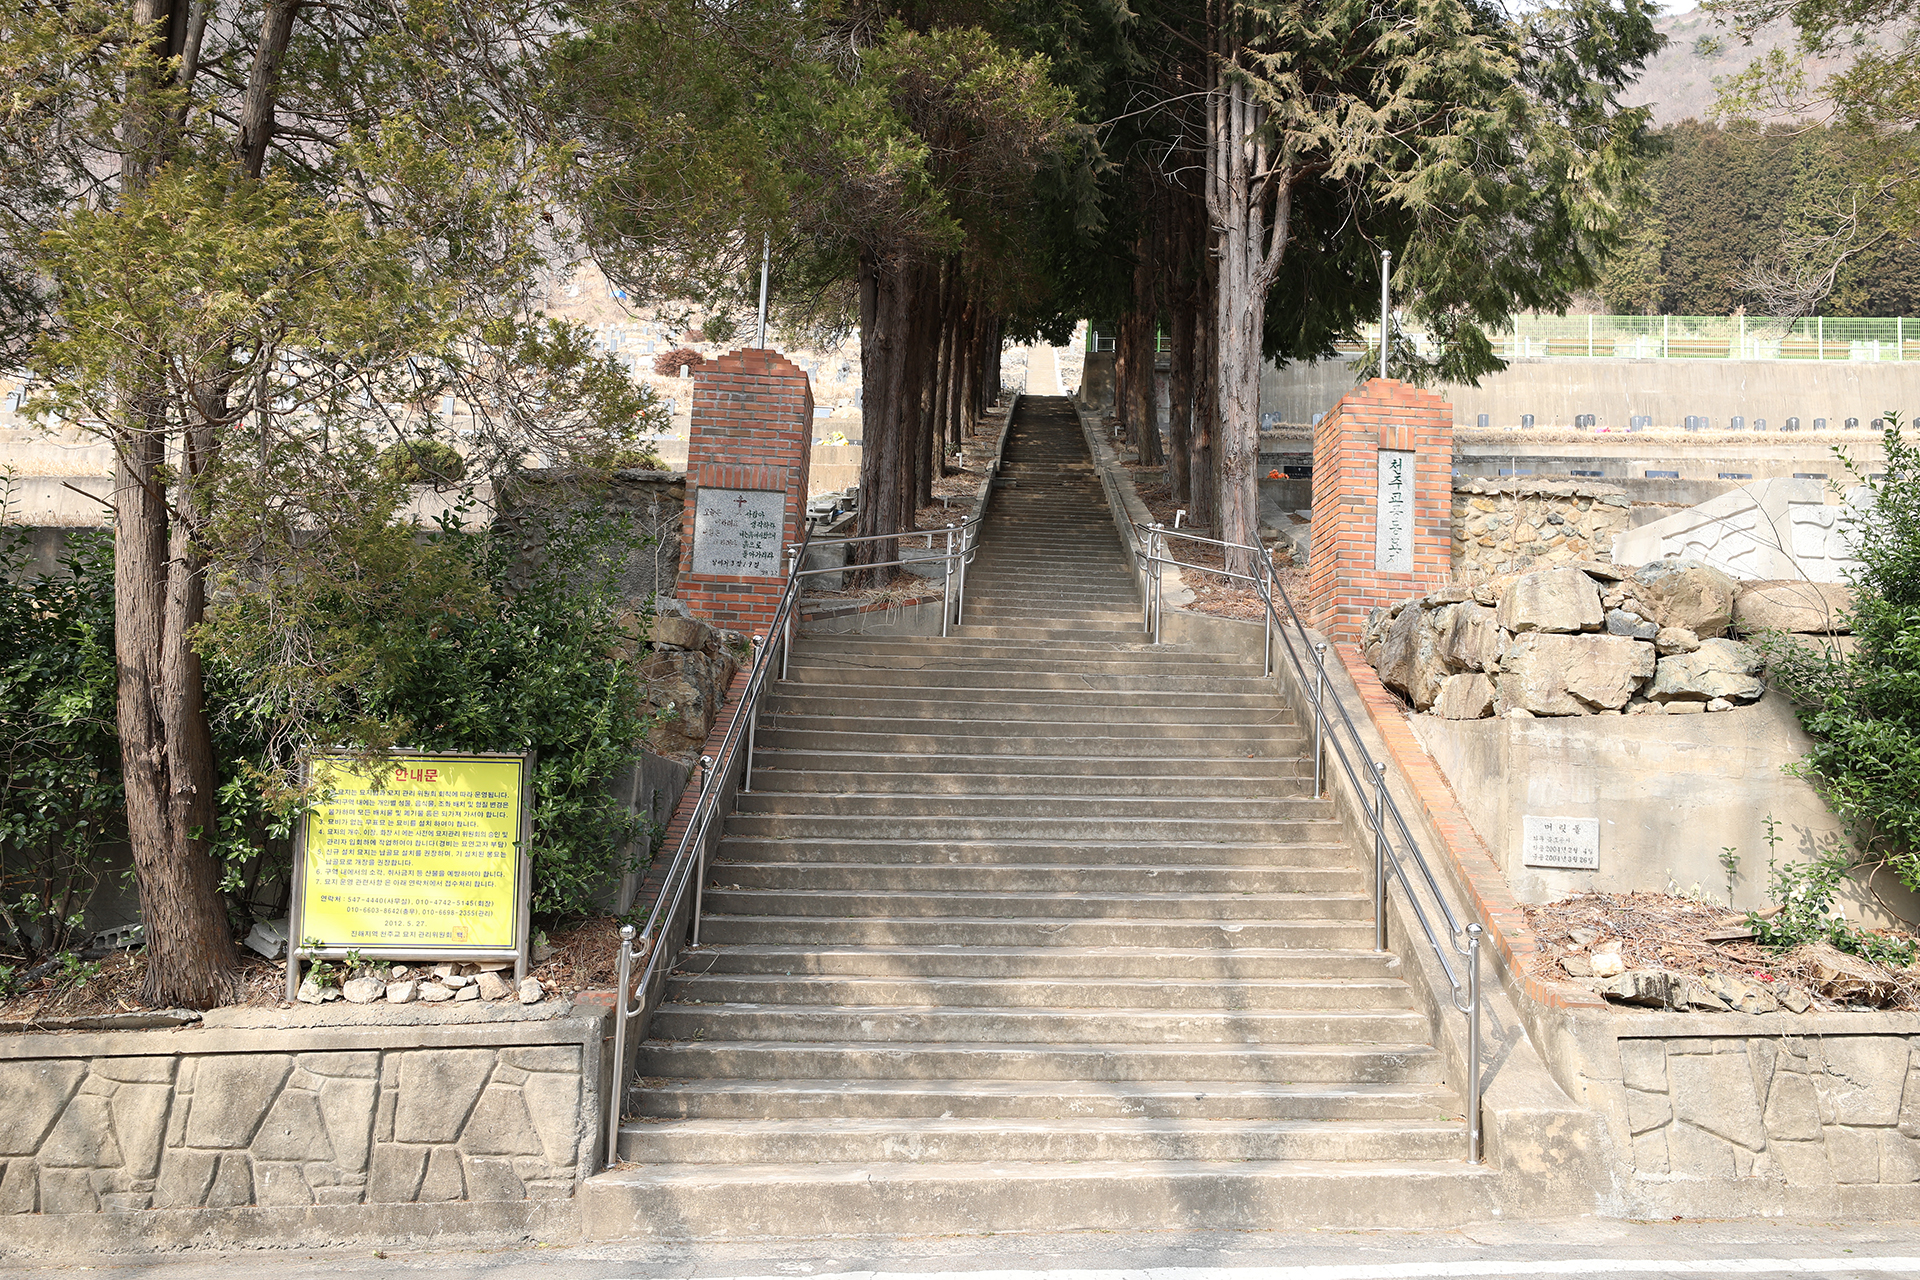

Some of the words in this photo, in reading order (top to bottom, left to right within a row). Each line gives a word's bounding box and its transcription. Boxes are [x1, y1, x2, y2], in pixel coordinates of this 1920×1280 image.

[395, 768, 438, 782] 안내문
[417, 790, 436, 798] 위원회
[418, 820, 432, 828] 설치
[326, 838, 347, 846] 관리자
